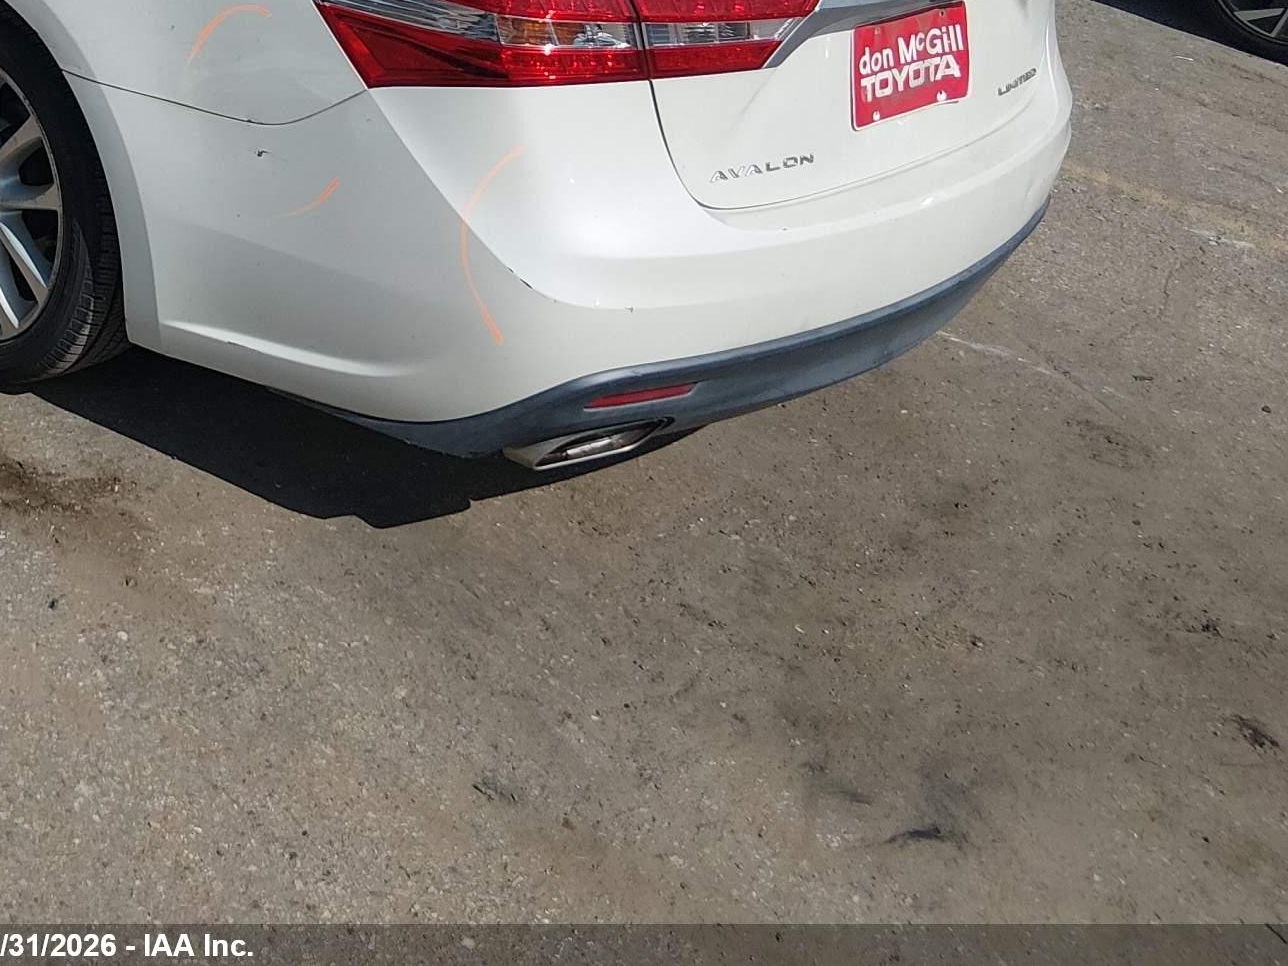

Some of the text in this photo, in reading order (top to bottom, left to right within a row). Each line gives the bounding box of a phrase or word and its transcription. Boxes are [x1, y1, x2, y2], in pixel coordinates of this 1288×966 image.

[859, 24, 964, 75] don McGill
[860, 54, 962, 103] TOYOTA
[997, 67, 1037, 96] LIMITED
[710, 153, 814, 183] AVALON
